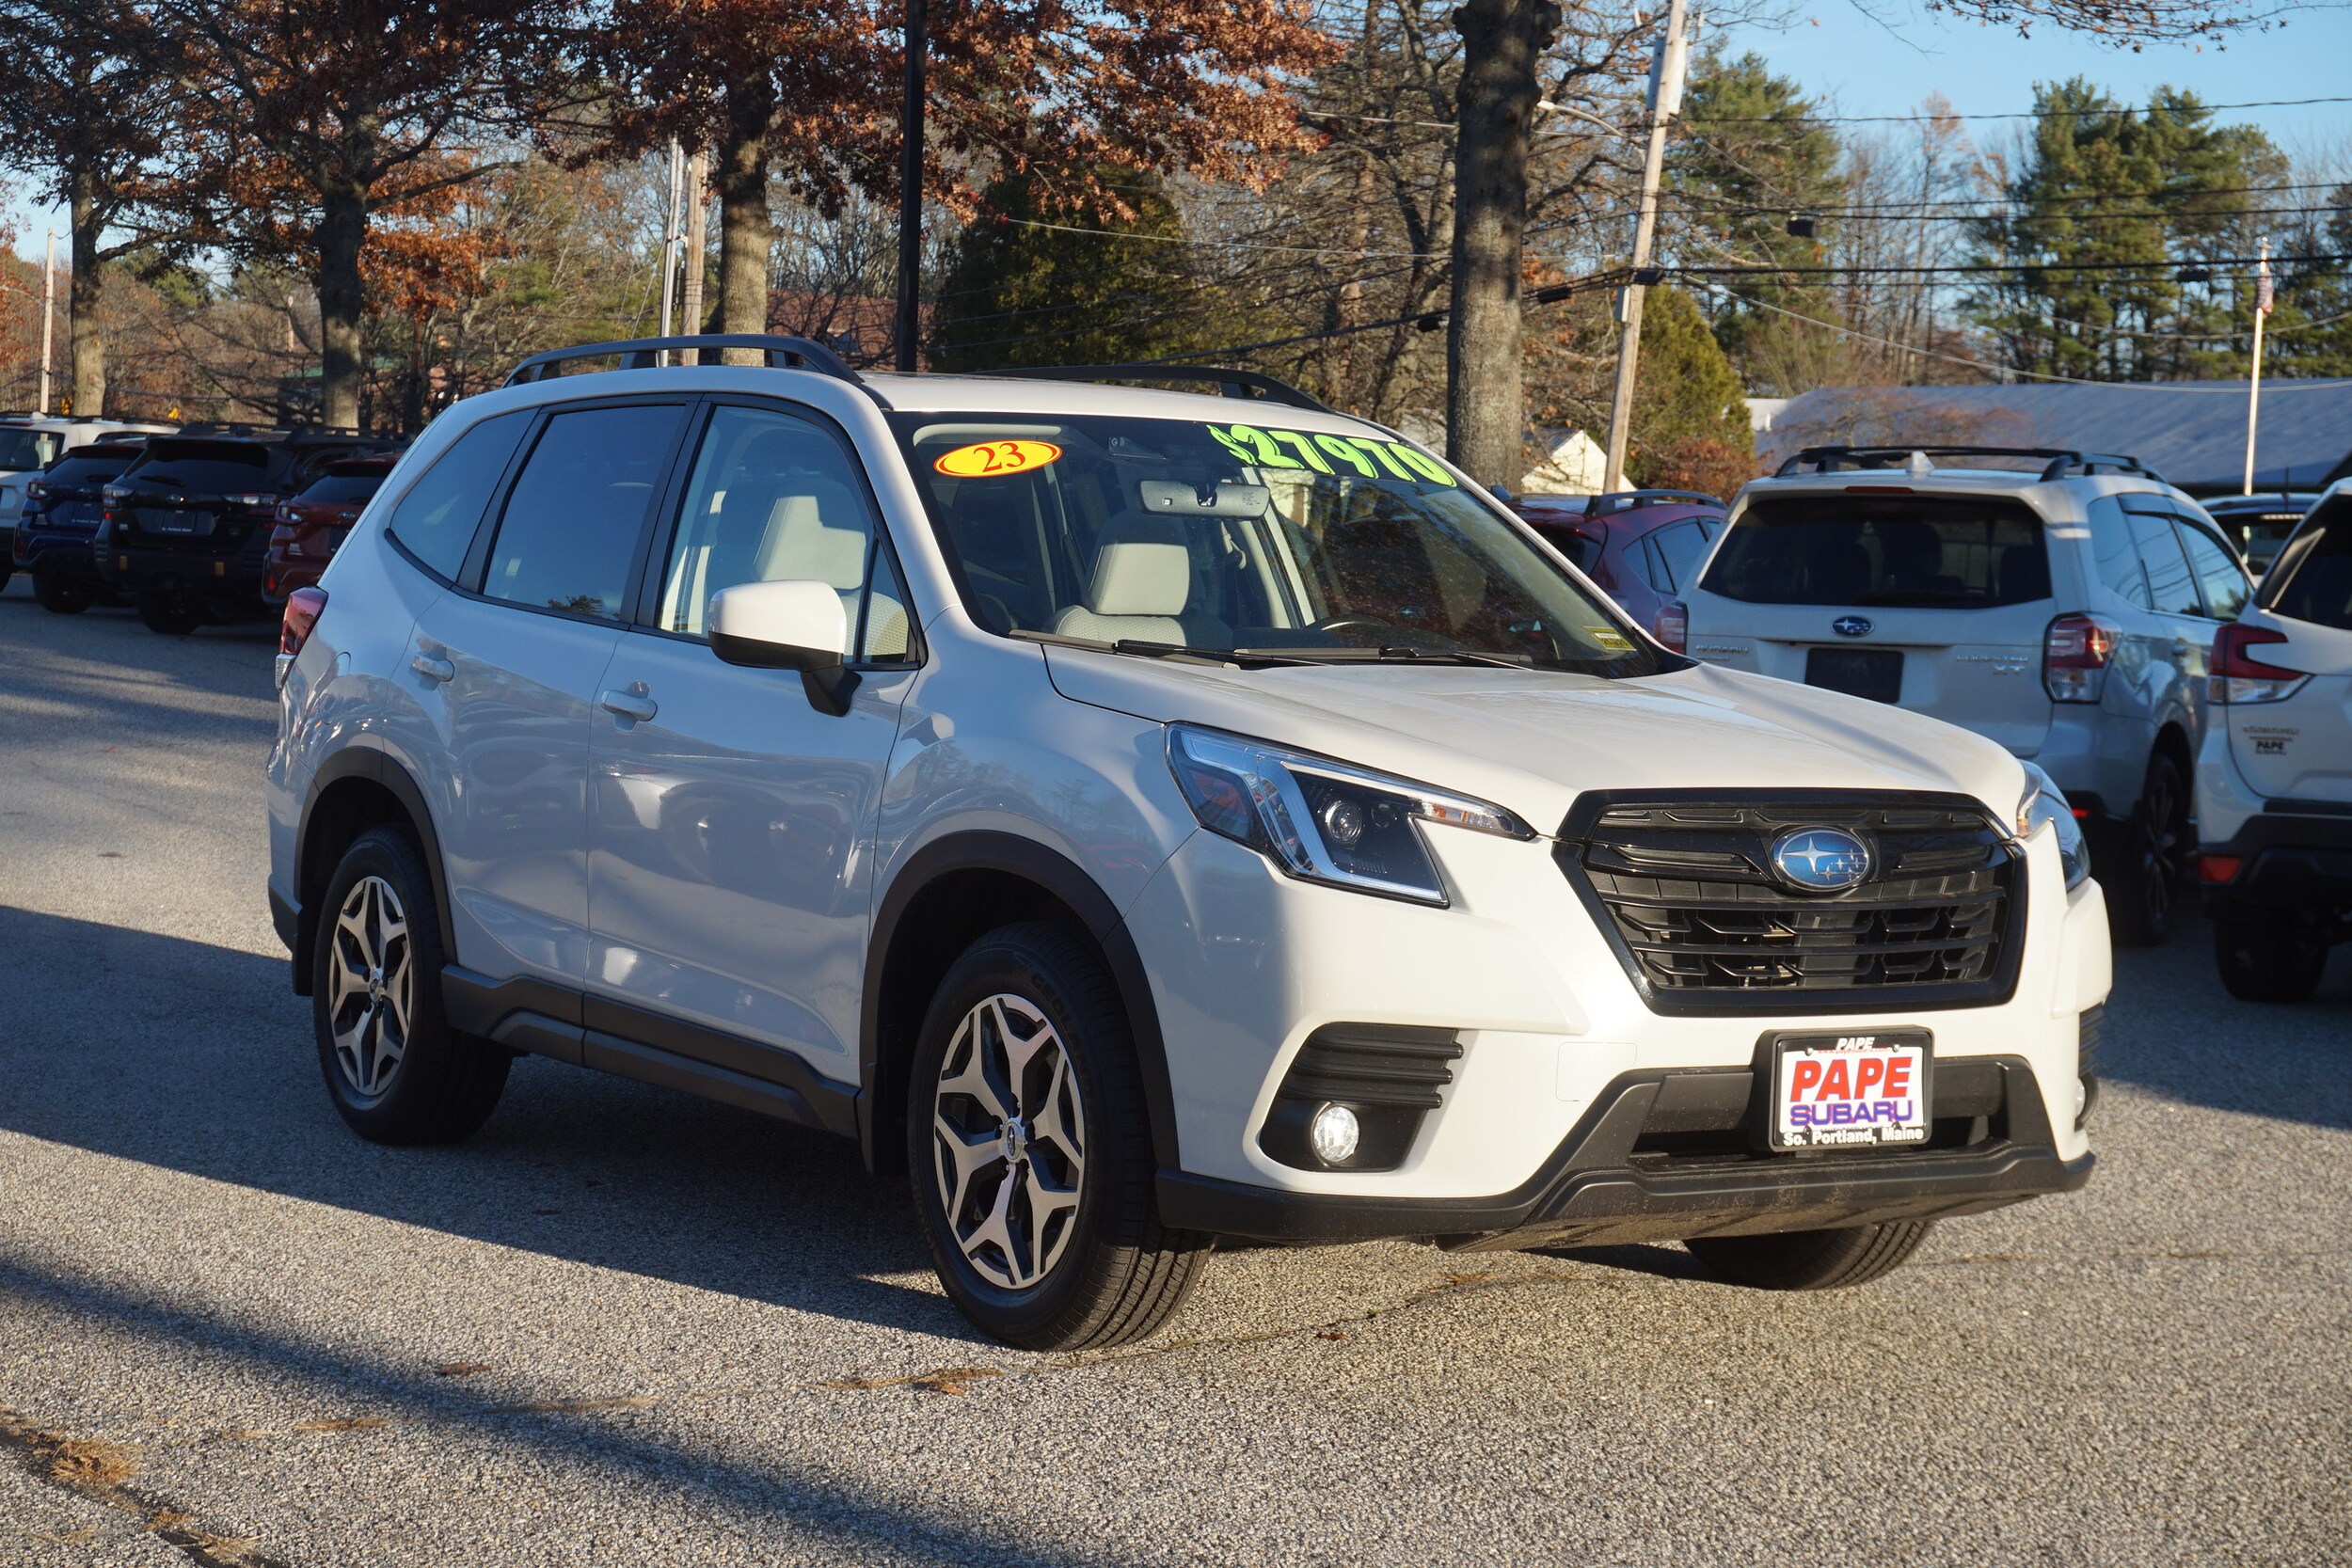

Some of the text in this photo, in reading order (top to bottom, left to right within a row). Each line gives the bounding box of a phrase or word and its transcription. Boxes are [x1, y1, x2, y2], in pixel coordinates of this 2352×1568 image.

[973, 442, 1026, 473] 23
[1206, 424, 1457, 487] $27970
[1836, 1037, 1876, 1051] PAPE
[1789, 1056, 1914, 1102] PAPE
[1789, 1100, 1914, 1126] SUBARU
[1783, 1126, 1924, 1147] So. Portland, Maine
